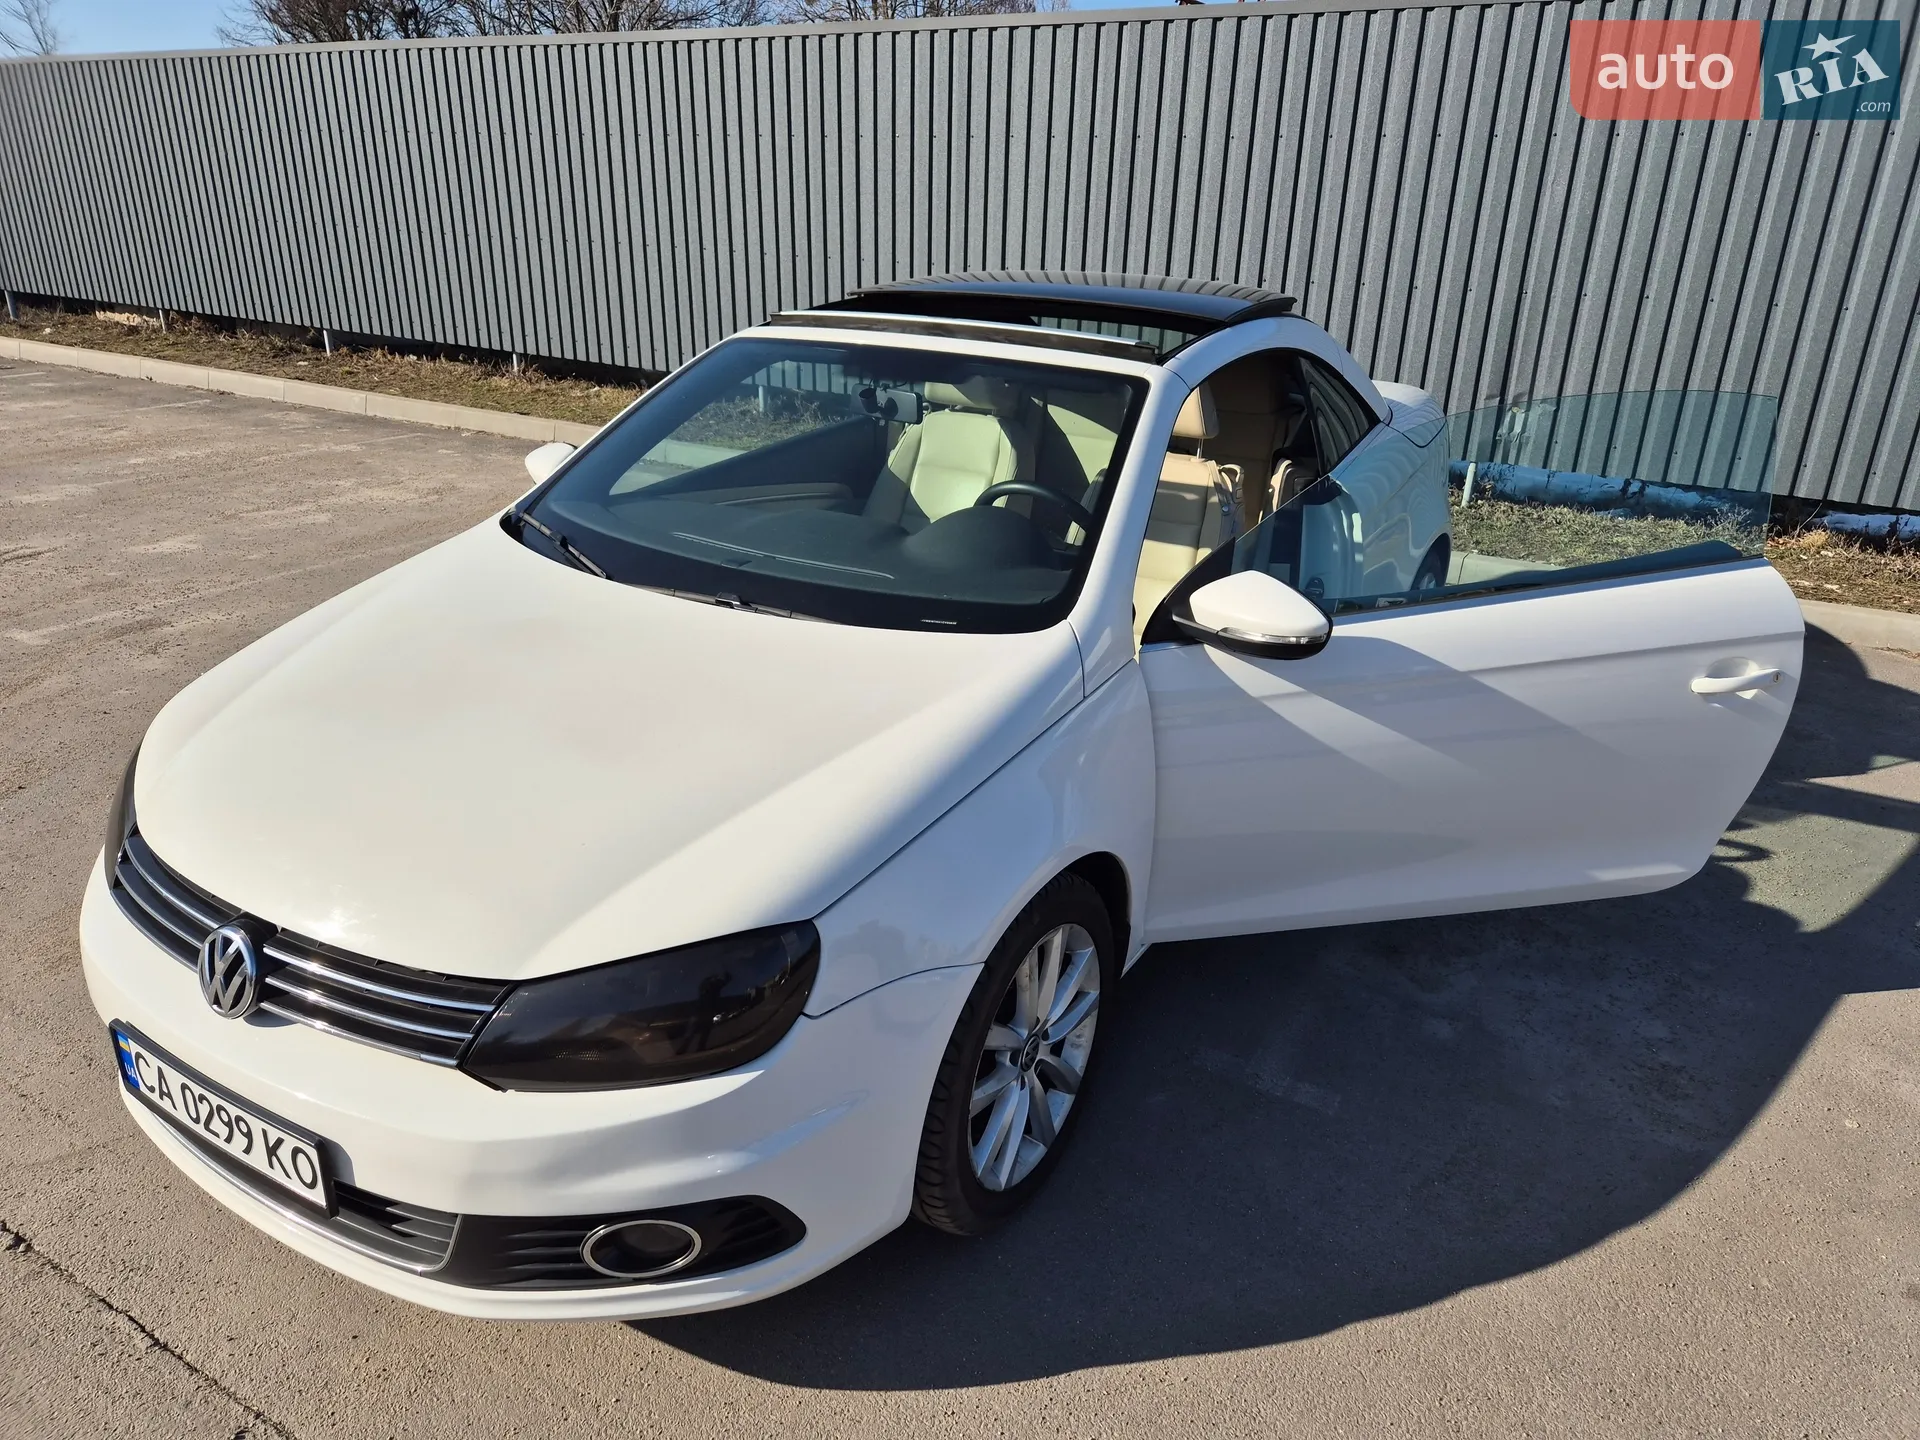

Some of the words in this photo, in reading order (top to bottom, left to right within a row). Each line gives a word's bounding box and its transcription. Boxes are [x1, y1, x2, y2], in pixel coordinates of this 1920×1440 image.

[124, 1062, 138, 1081] UA
[134, 1051, 178, 1111] CA
[180, 1082, 254, 1156] 0299
[261, 1128, 318, 1190] KO
